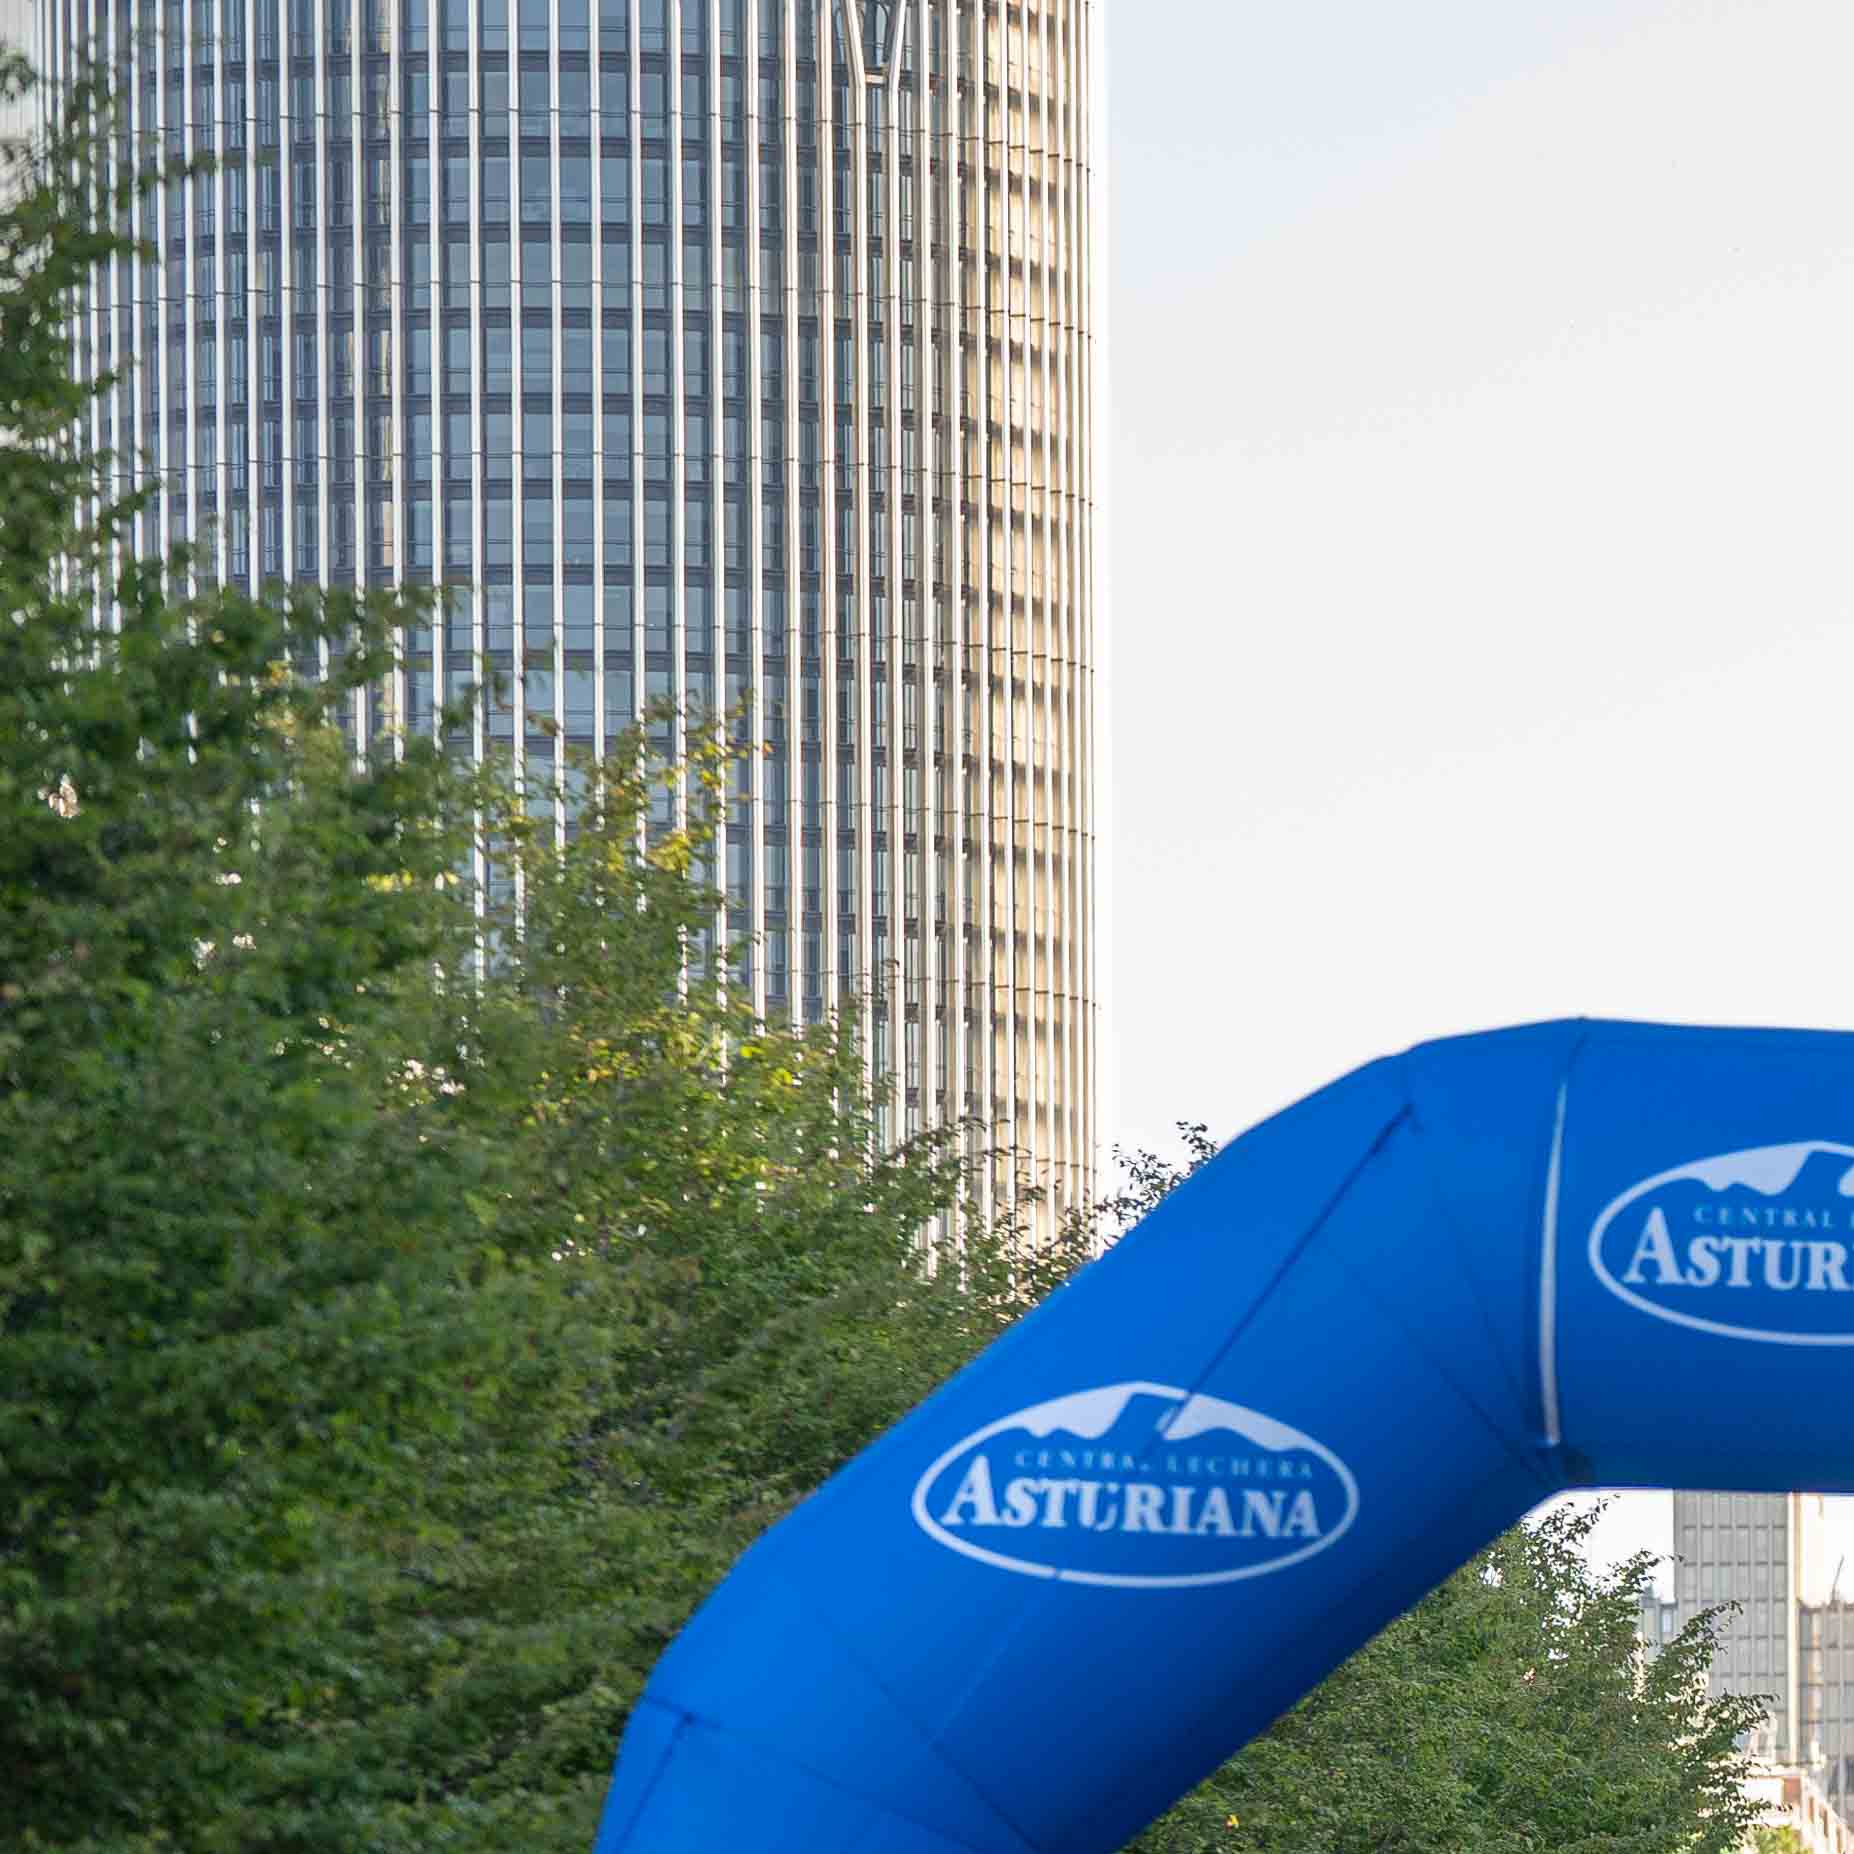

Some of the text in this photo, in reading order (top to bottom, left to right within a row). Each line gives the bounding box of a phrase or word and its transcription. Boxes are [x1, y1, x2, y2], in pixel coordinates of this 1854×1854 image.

[1694, 1204, 1834, 1229] CENTRAL
[1166, 1456, 1313, 1479] LECHERA
[940, 1455, 1323, 1538] ASTURIANA
